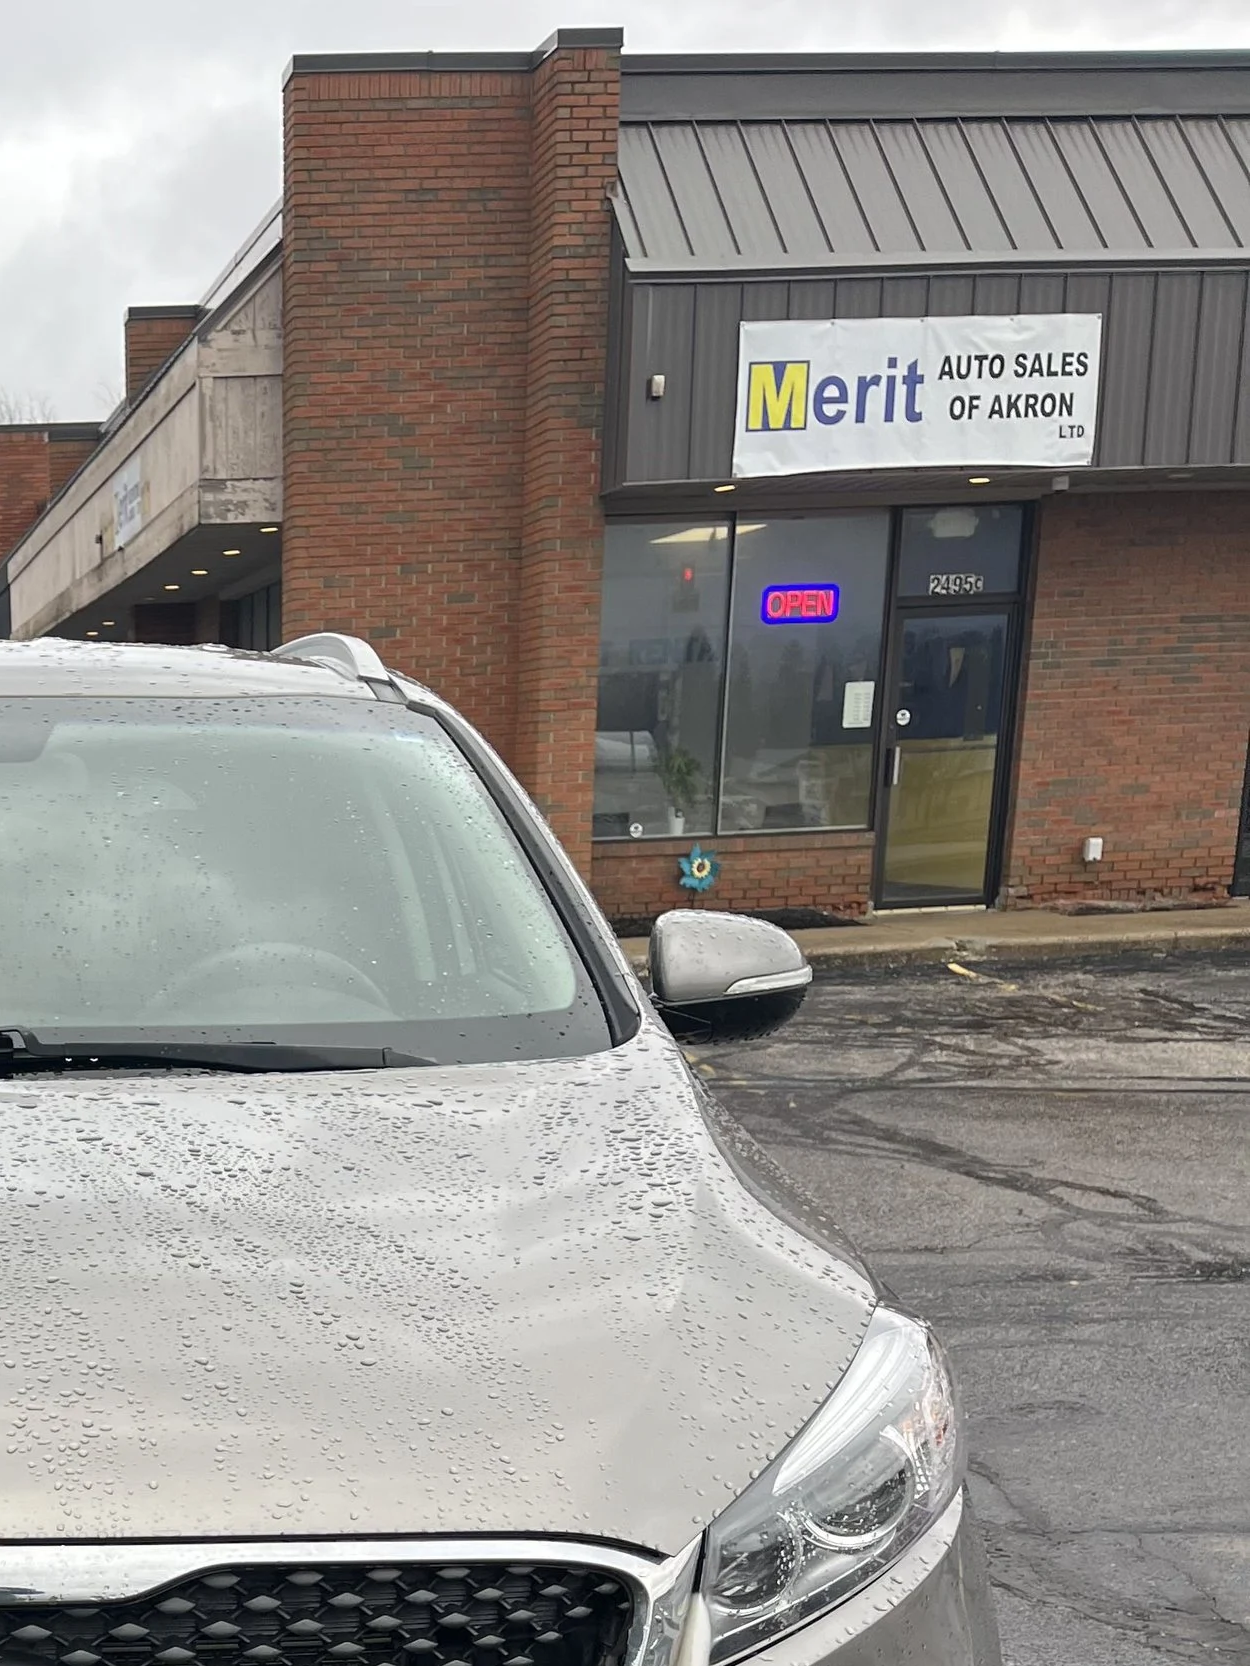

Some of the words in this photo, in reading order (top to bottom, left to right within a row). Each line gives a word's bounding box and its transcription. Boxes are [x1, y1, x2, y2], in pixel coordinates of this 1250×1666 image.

[937, 354, 1006, 380] AUTO
[1013, 351, 1090, 378] SALES
[745, 357, 925, 432] Merit
[949, 395, 981, 420] OF
[987, 391, 1075, 420] AKRON
[1058, 424, 1085, 439] LTD
[767, 590, 834, 618] OPEN
